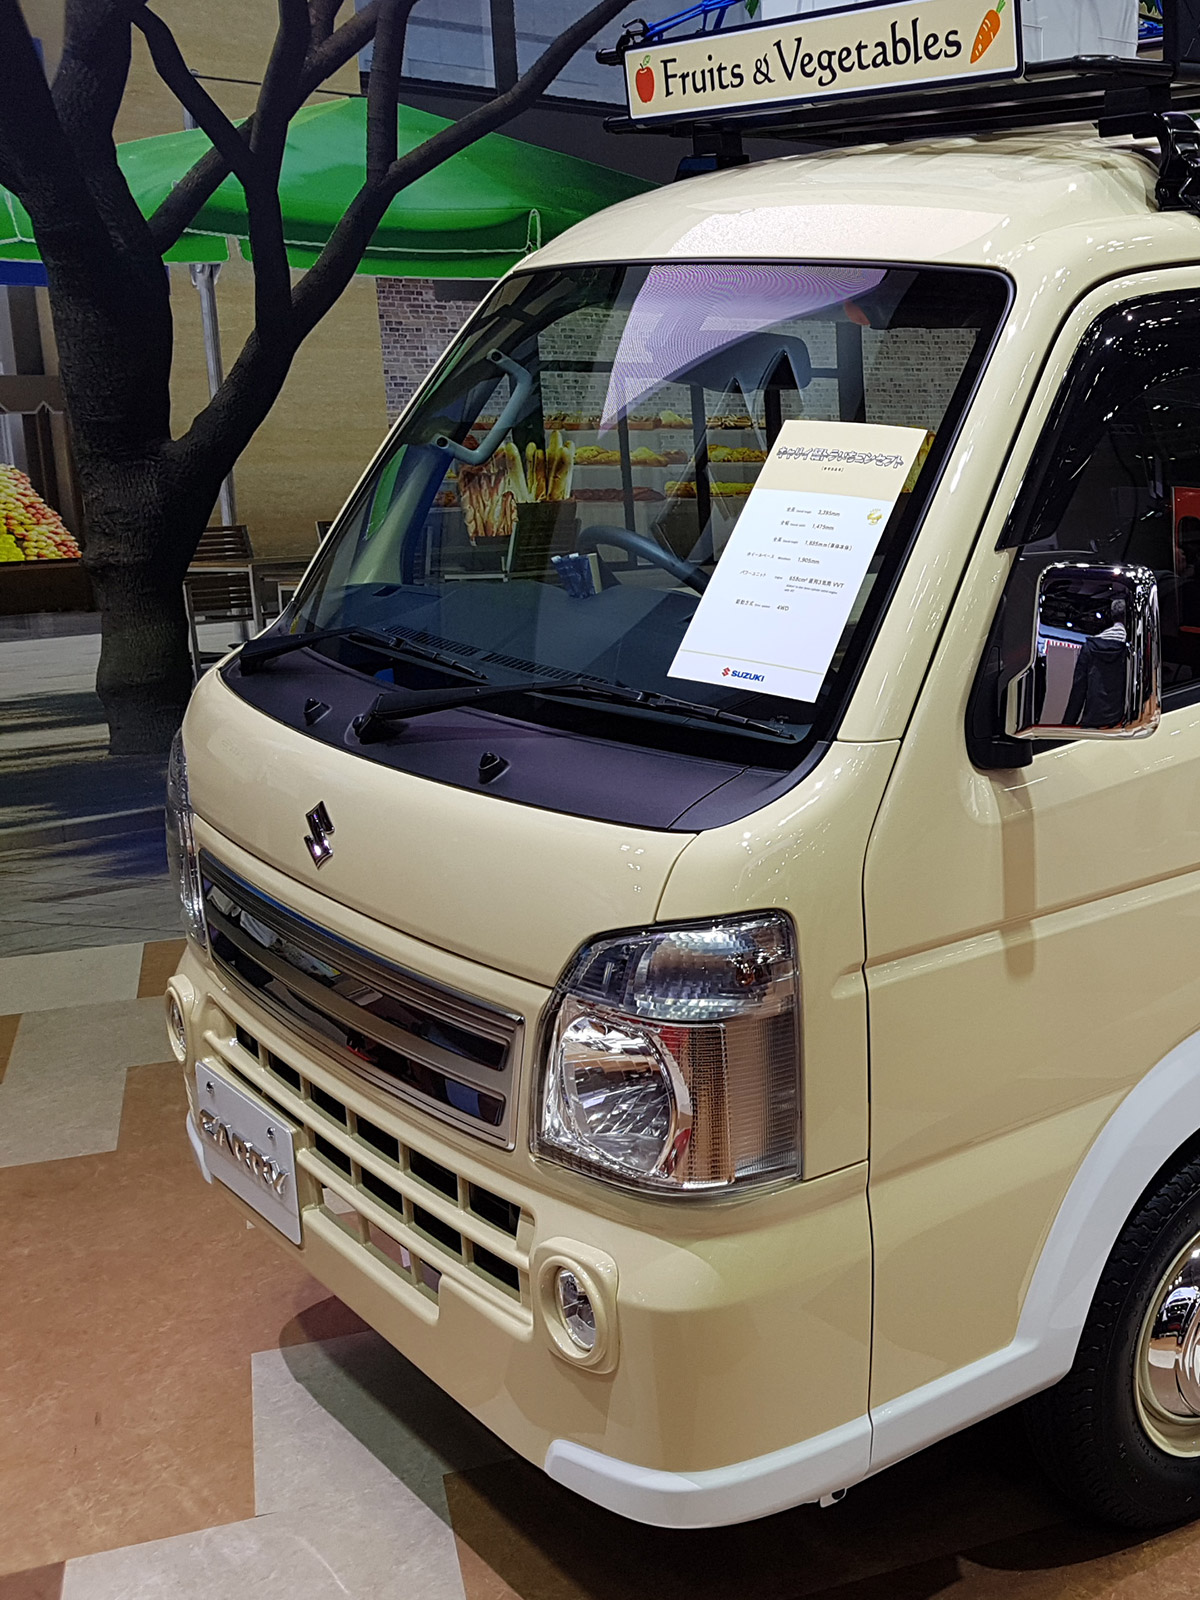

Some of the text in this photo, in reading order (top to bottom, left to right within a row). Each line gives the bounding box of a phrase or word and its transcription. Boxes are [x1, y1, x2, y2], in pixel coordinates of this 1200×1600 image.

[660, 17, 963, 98] Fruits & Vegetables
[731, 670, 765, 682] SUZUKI
[199, 1108, 290, 1195] CARRY
